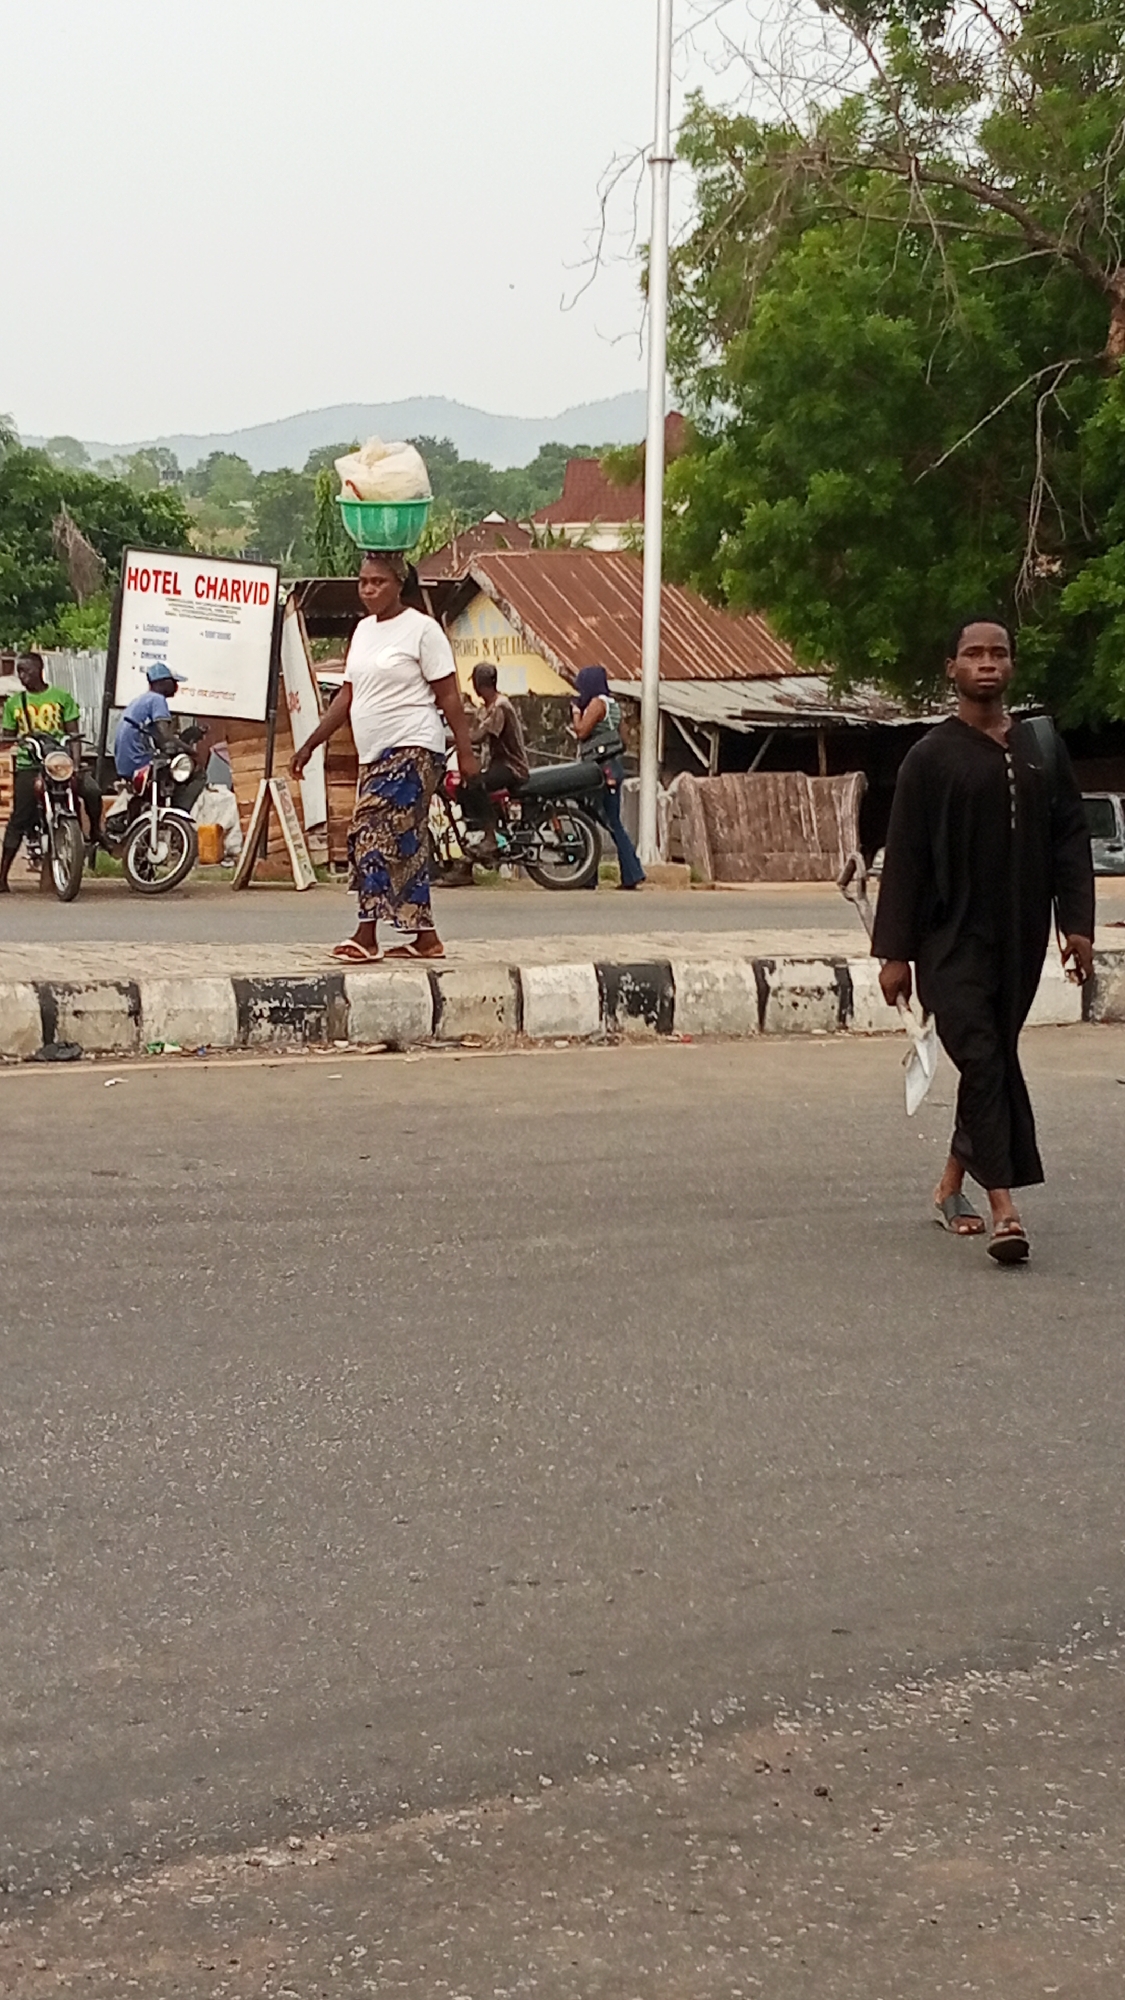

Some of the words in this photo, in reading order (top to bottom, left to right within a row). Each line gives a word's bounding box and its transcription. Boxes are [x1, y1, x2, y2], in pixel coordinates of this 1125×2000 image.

[127, 566, 182, 596] HOTEL
[194, 574, 270, 606] CHARVID
[453, 638, 479, 657] RONG
